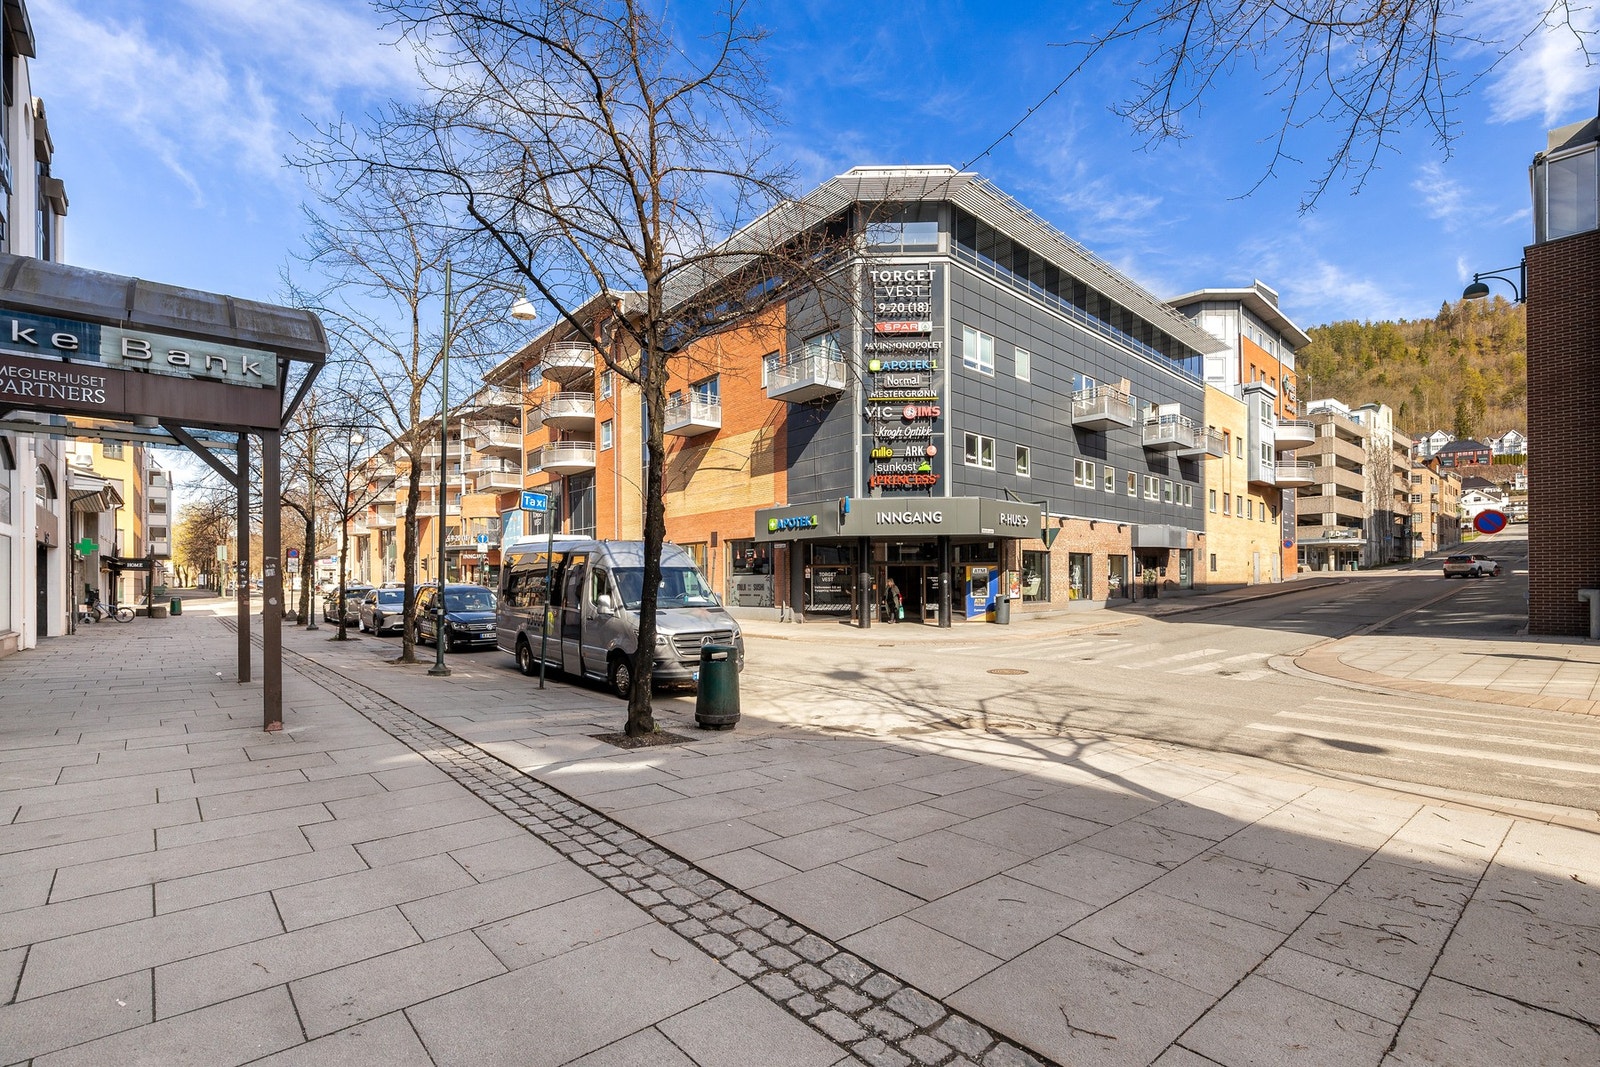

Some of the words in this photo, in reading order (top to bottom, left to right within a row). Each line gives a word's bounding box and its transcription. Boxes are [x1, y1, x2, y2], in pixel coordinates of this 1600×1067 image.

[870, 270, 936, 282] TORGET
[885, 285, 924, 297] VEST
[879, 302, 905, 313] 9-20
[908, 302, 929, 314] (18)
[884, 323, 918, 331] SPAR
[874, 341, 943, 349] VINMONOPOLET
[121, 336, 262, 378] Bank
[882, 360, 929, 369] APOTEK
[887, 376, 920, 385] Normal
[864, 406, 893, 418] VIC
[878, 426, 902, 439] Krogh
[904, 426, 932, 438] Optikk
[871, 447, 893, 458] nille
[905, 446, 924, 456] ARK
[877, 462, 917, 472] sunkost
[876, 475, 936, 485] PRINCESS
[524, 496, 546, 508] Taxi
[777, 516, 811, 529] APOTEK
[812, 515, 819, 525] 1
[877, 511, 942, 523] INNGANG
[1000, 513, 1021, 525] P-HUS
